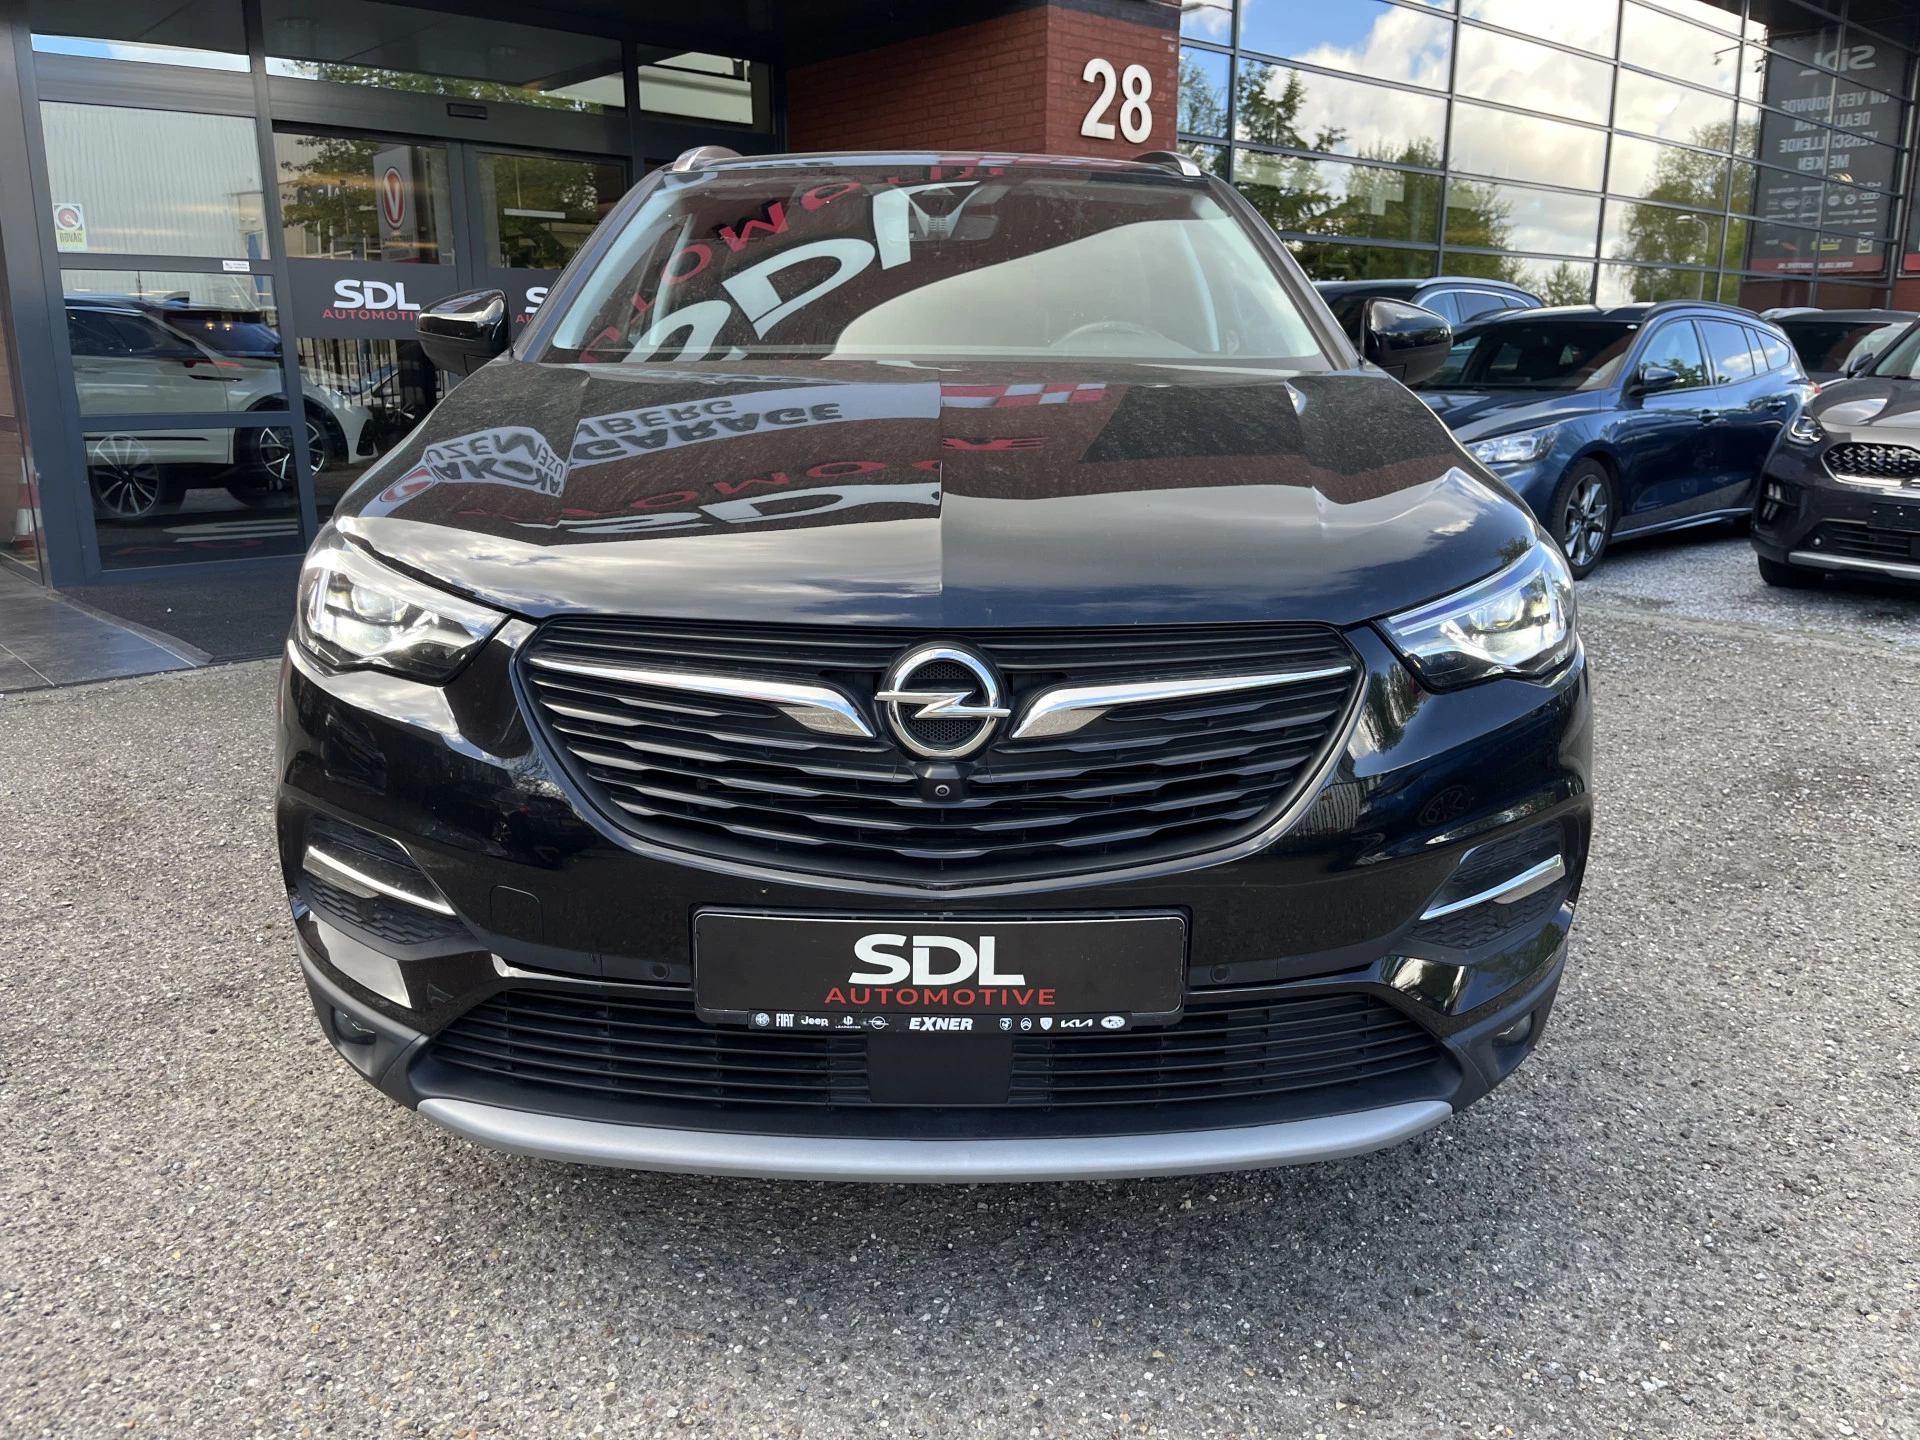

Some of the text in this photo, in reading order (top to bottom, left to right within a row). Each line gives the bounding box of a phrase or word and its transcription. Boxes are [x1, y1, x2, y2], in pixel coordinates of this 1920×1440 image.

[1081, 58, 1152, 143] 28
[60, 232, 83, 243] BOVAG
[333, 279, 421, 310] SDL
[848, 933, 1026, 986] SDL
[824, 987, 1056, 1006] AUTOMOTIVE
[775, 1013, 795, 1027] FIAT
[801, 1015, 829, 1027] Jeep
[908, 1016, 974, 1031] EXNER
